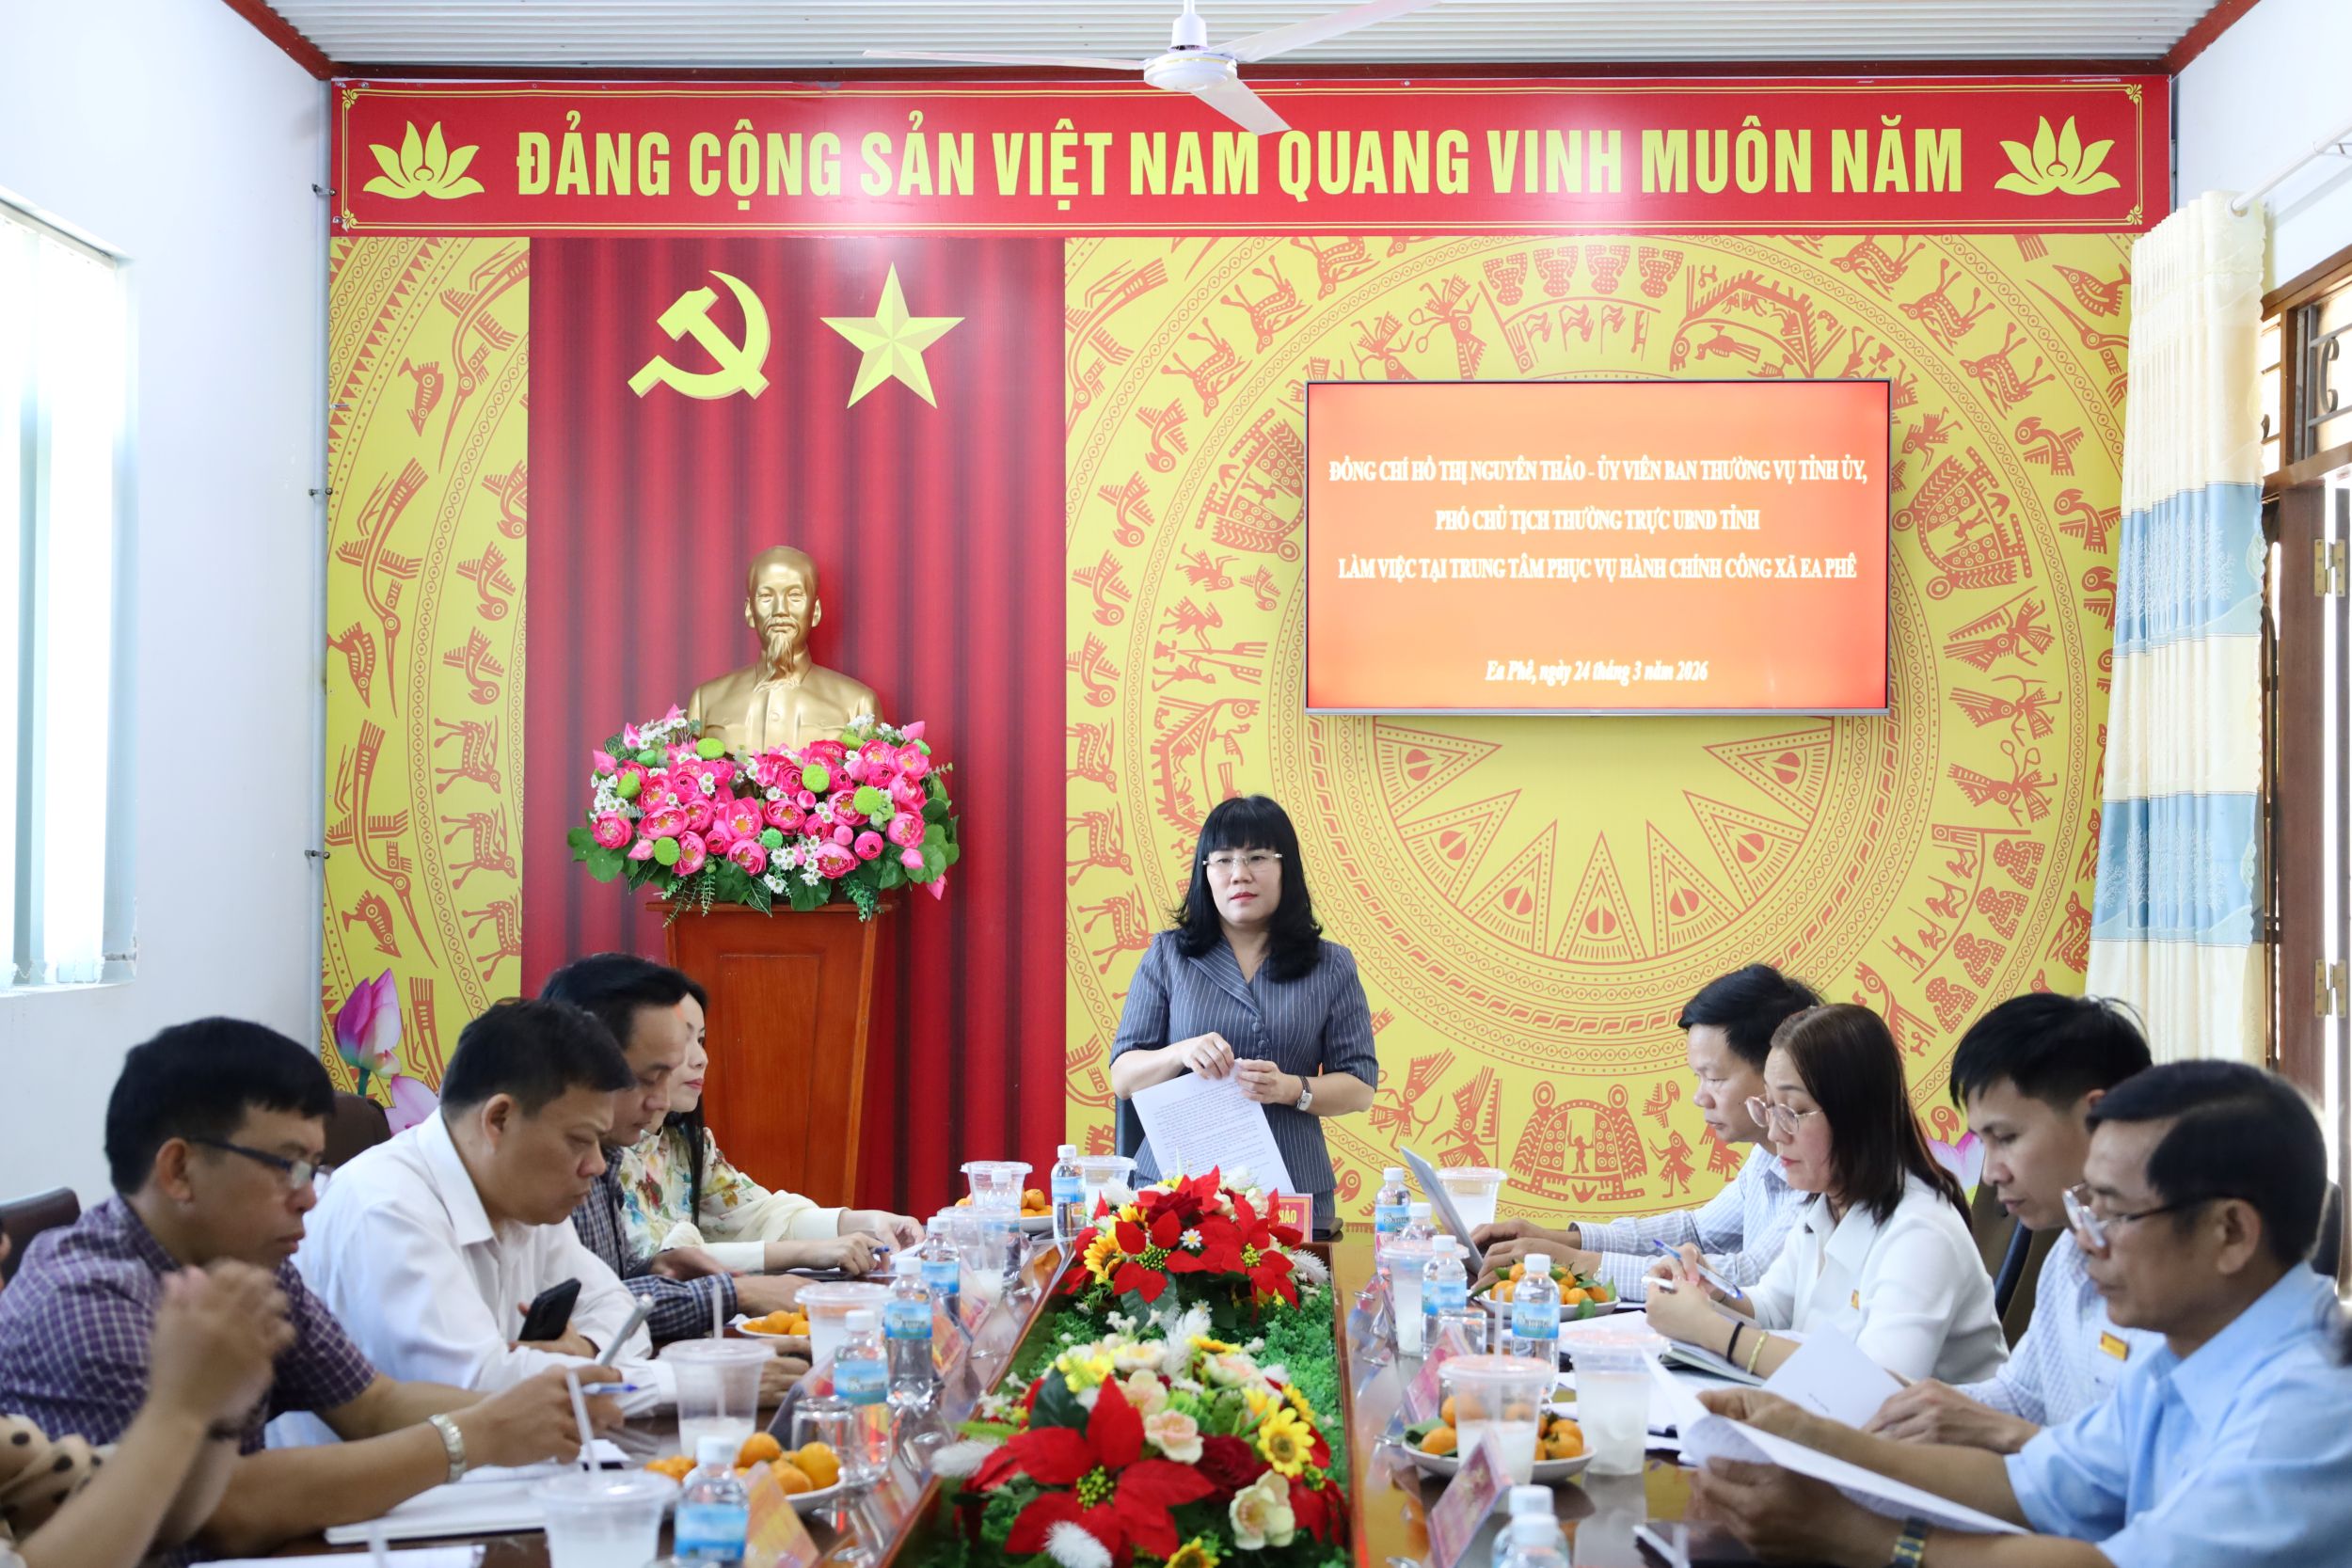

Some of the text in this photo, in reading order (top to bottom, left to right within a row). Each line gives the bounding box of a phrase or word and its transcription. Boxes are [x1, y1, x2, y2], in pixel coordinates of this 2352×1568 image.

[516, 111, 1963, 211] ĐẢNG CỘNG SẢN VIỆT NAM QUANG VINH MUÔN NĂM
[1329, 455, 1375, 481] ĐỒNG
[1379, 456, 1408, 481] CHÍ
[1411, 455, 1437, 481] HỒ
[1438, 460, 1468, 484] THỊ
[1470, 455, 1537, 481] NGUYÊN
[1540, 455, 1585, 481] THẢO
[1597, 455, 1620, 480] ỦY
[1623, 455, 1661, 480] VIÊN
[1664, 460, 1697, 481] BAN
[1700, 456, 1771, 481] THƯỜNG
[1773, 460, 1796, 484] VỤ
[1799, 454, 1837, 480] TỈNH
[1841, 454, 1867, 483] ỦY,
[1435, 504, 1760, 534] PHÓ CHỦ TỊCH THƯỜNG TRỰC UBND TỈNH
[1338, 553, 1857, 582] LÀM VIỆC TẠI TRUNG TÂM PHỤC VỤ HÀNH CHÍNH CÔNG XÃ EA PHÊ
[1485, 659, 1708, 687] Ea Phê, ngày 24 tháng 3 năm 2026
[1279, 1205, 1297, 1224] HẢO
